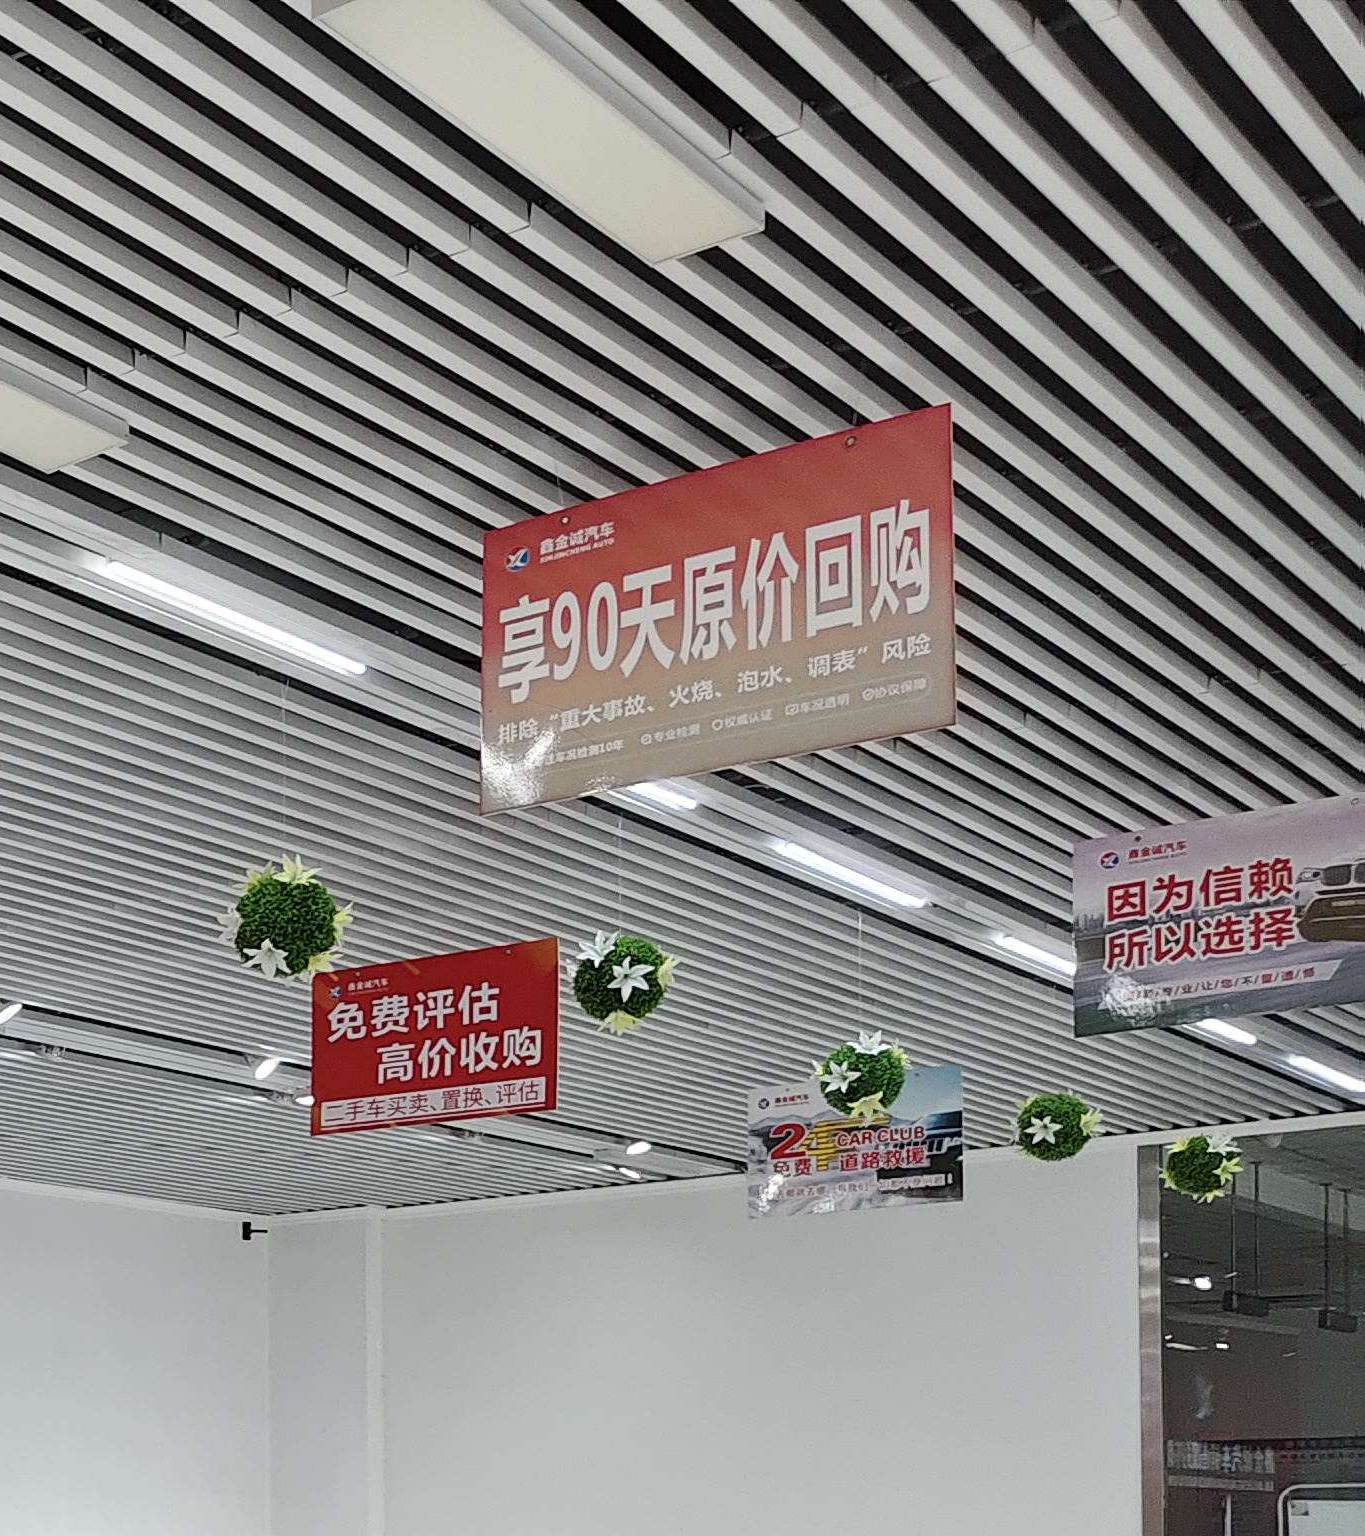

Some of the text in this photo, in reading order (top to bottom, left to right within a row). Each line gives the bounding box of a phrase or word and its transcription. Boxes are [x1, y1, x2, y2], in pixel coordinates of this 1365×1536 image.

[498, 500, 930, 703] 享90天原价回购
[498, 718, 539, 745] 排除
[881, 632, 932, 664] 风险
[1107, 857, 1294, 922] 因为信赖
[1106, 908, 1296, 971] 所以选择
[327, 981, 500, 1043] 免费评估
[376, 1025, 542, 1084] 高价收购
[324, 1080, 540, 1122] 二手车买卖、置换、评估
[772, 1147, 926, 1176] 免费 道路救援
[836, 1125, 926, 1147] CAR CLUB
